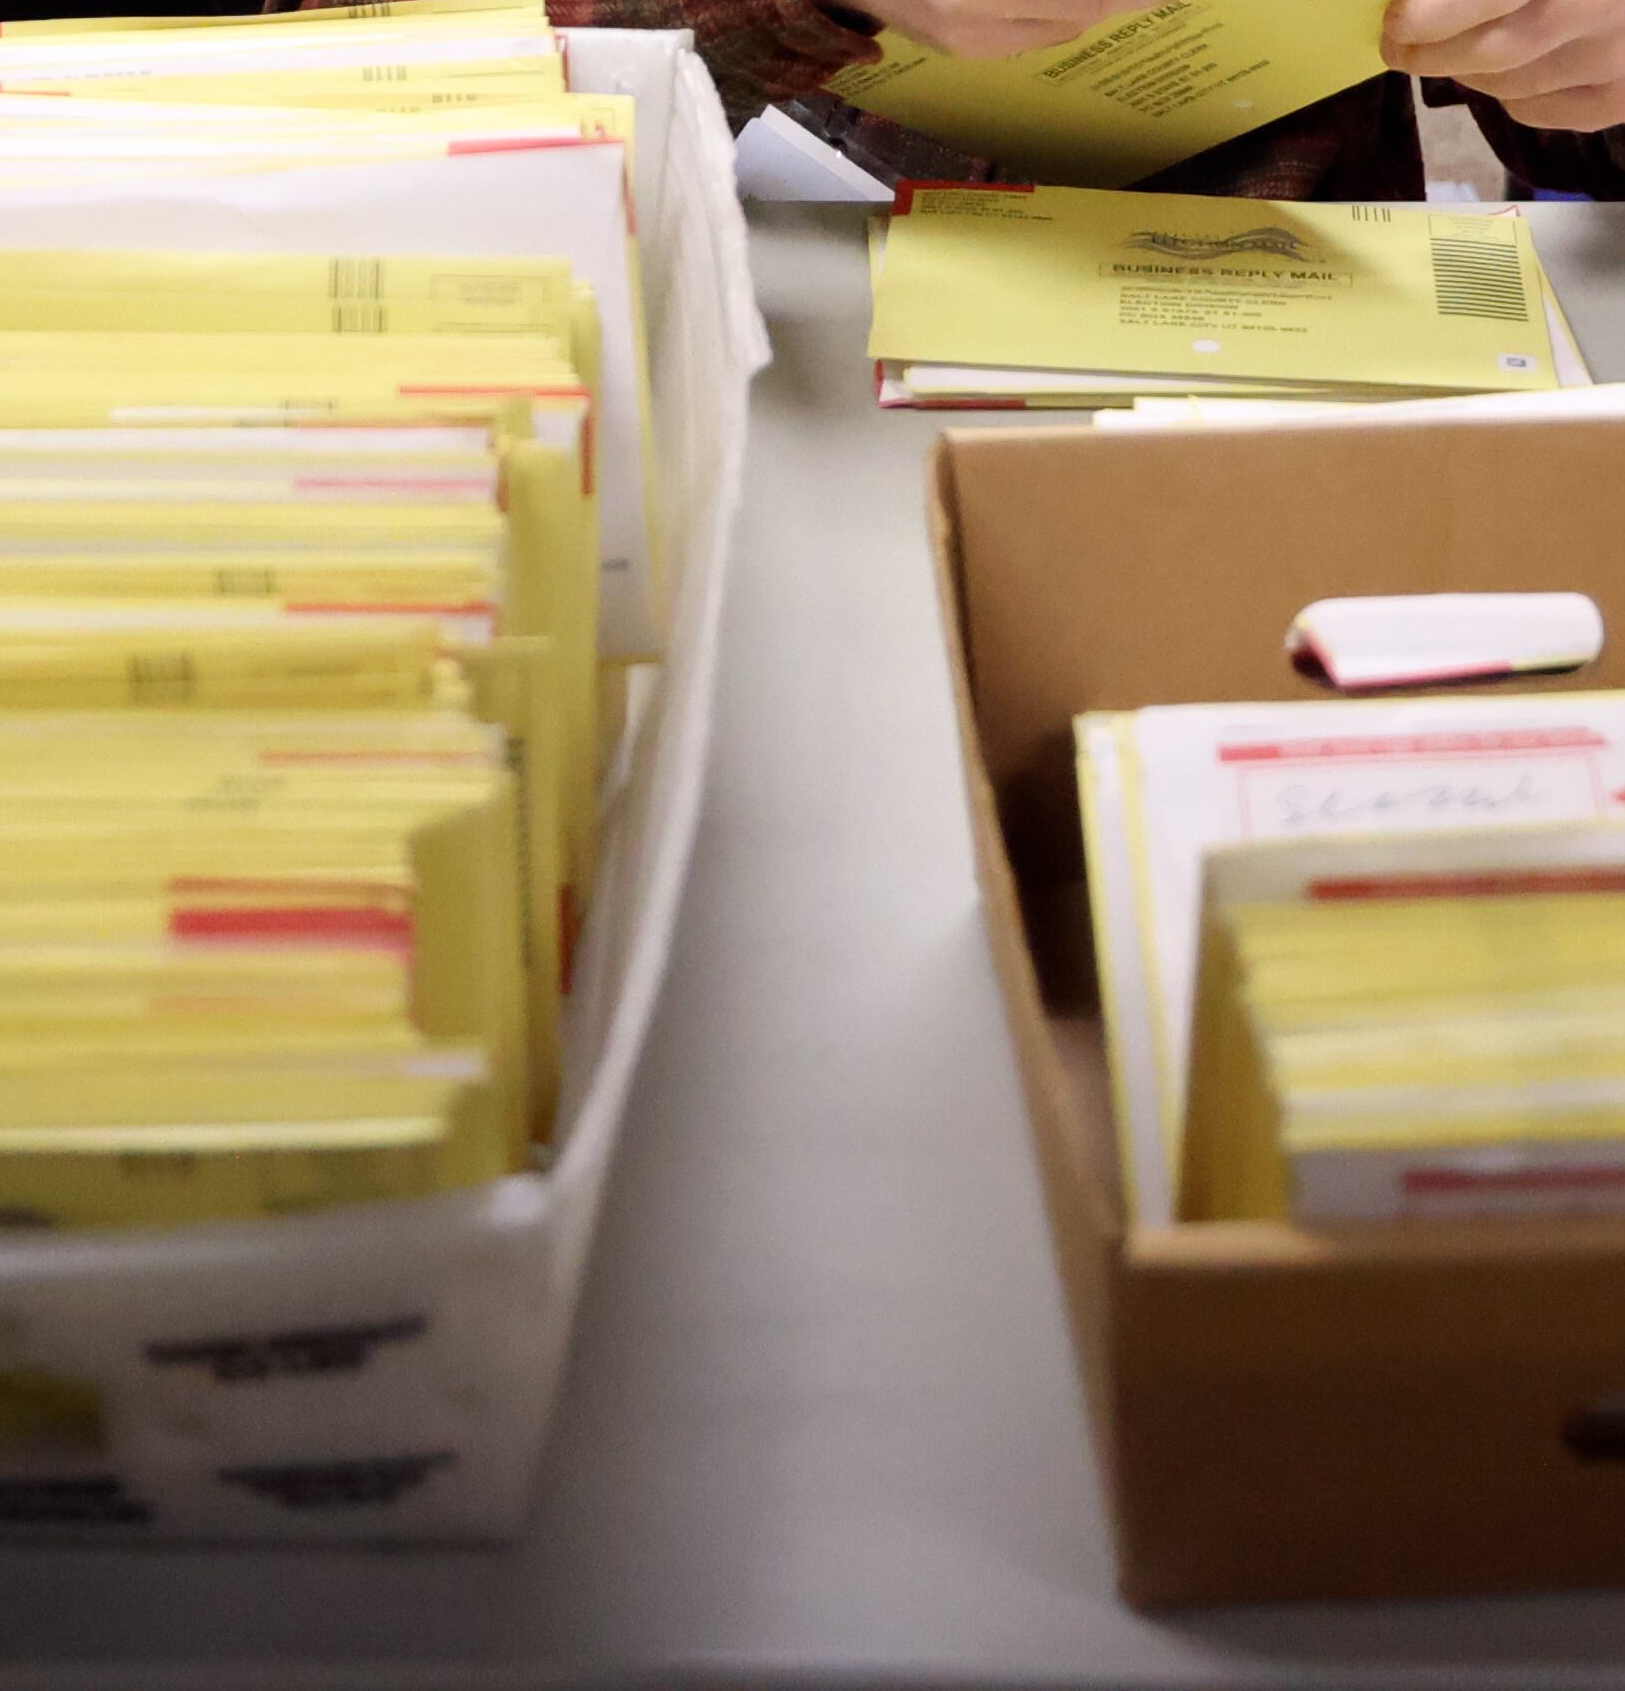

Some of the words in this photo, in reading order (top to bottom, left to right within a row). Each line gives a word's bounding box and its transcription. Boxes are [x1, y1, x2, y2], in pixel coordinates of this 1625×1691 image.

[1043, 39, 1113, 78] BUSINESS
[1109, 17, 1154, 44] REPLY
[1154, 0, 1192, 21] MAIL
[1113, 264, 1215, 276] BUSINESS
[1219, 268, 1284, 279] REPLY
[1289, 270, 1336, 282] MAIL
